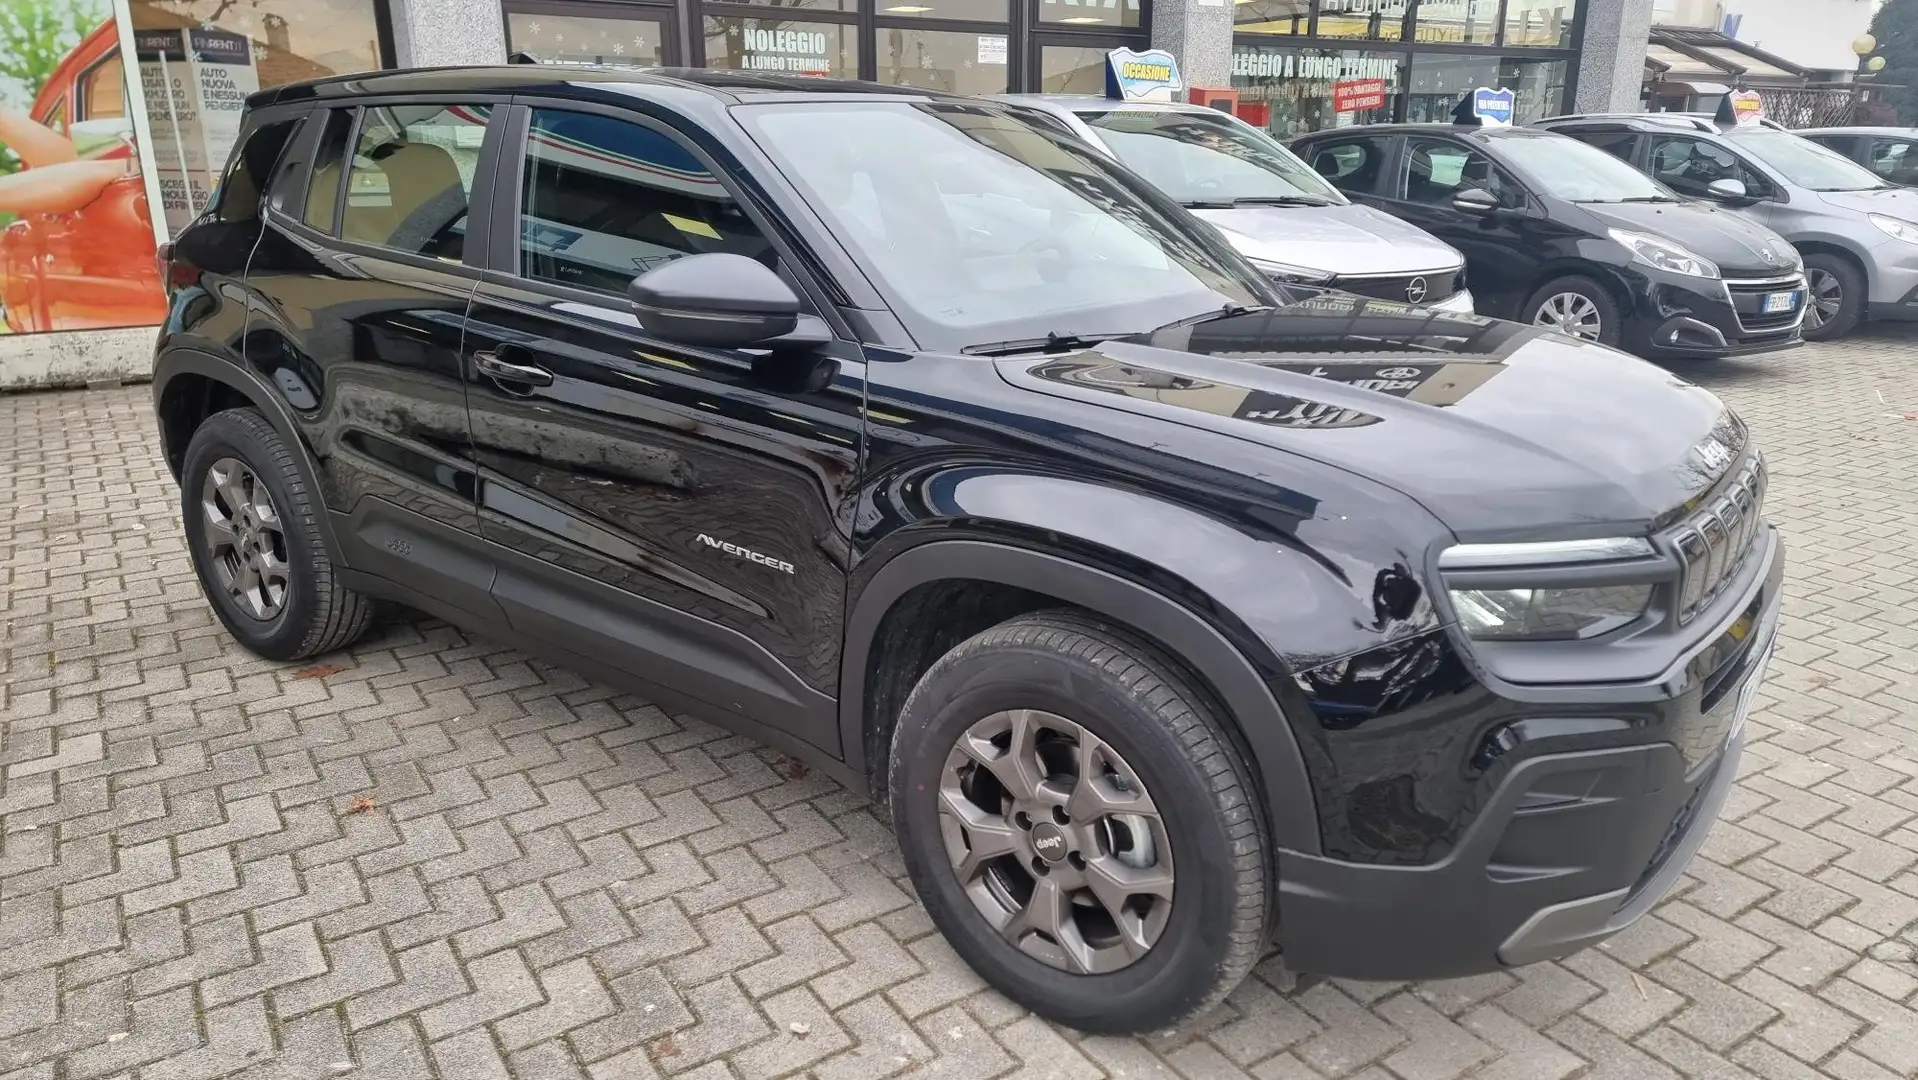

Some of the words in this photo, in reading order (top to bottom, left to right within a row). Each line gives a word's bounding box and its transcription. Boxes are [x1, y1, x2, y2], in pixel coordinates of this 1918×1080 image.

[743, 28, 826, 55] NOLEGGIO
[742, 55, 750, 69] A
[751, 56, 785, 70] LUNGO
[786, 57, 831, 72] TERMINE
[1123, 62, 1171, 82] OCCASIONE
[1231, 53, 1282, 78] LEGGIO
[1284, 55, 1294, 78] A
[1298, 55, 1341, 79] LUNGO
[1344, 57, 1399, 81] TERMINE
[200, 68, 227, 78] AUTO
[202, 80, 236, 90] NUOVA
[696, 533, 795, 575] AVENGER
[1036, 836, 1061, 849] Jeep
